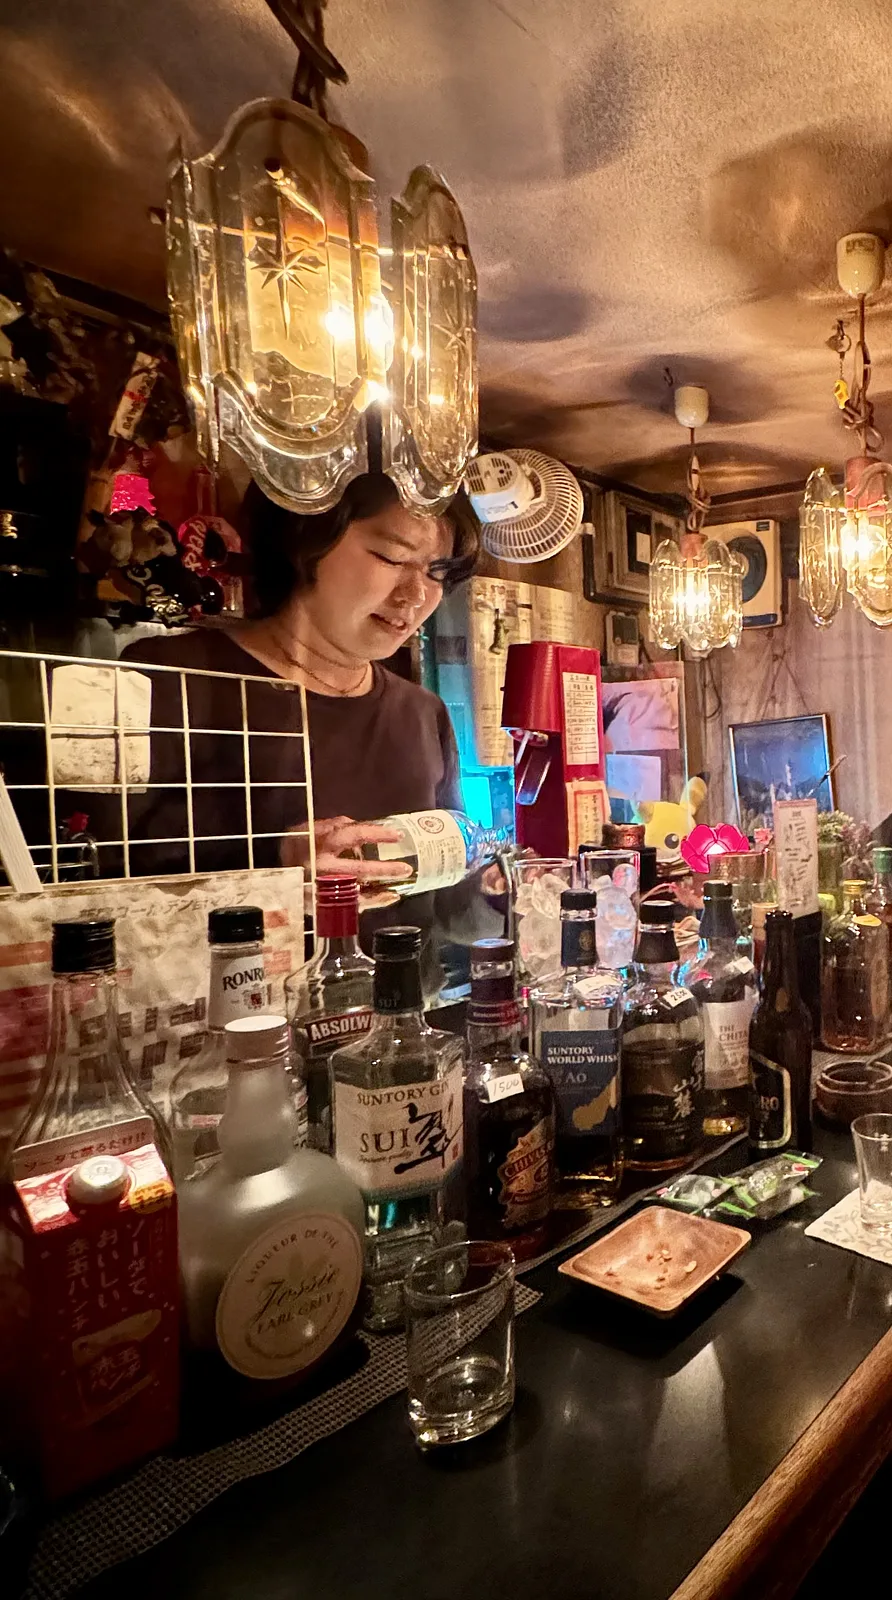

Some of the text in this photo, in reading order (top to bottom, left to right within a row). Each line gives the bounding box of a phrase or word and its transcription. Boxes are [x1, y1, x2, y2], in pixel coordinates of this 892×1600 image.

[547, 1046, 595, 1056] SUNTORY
[547, 1055, 586, 1065] WORLD
[357, 1087, 426, 1106] SUNTORY
[360, 1128, 410, 1153] SUI
